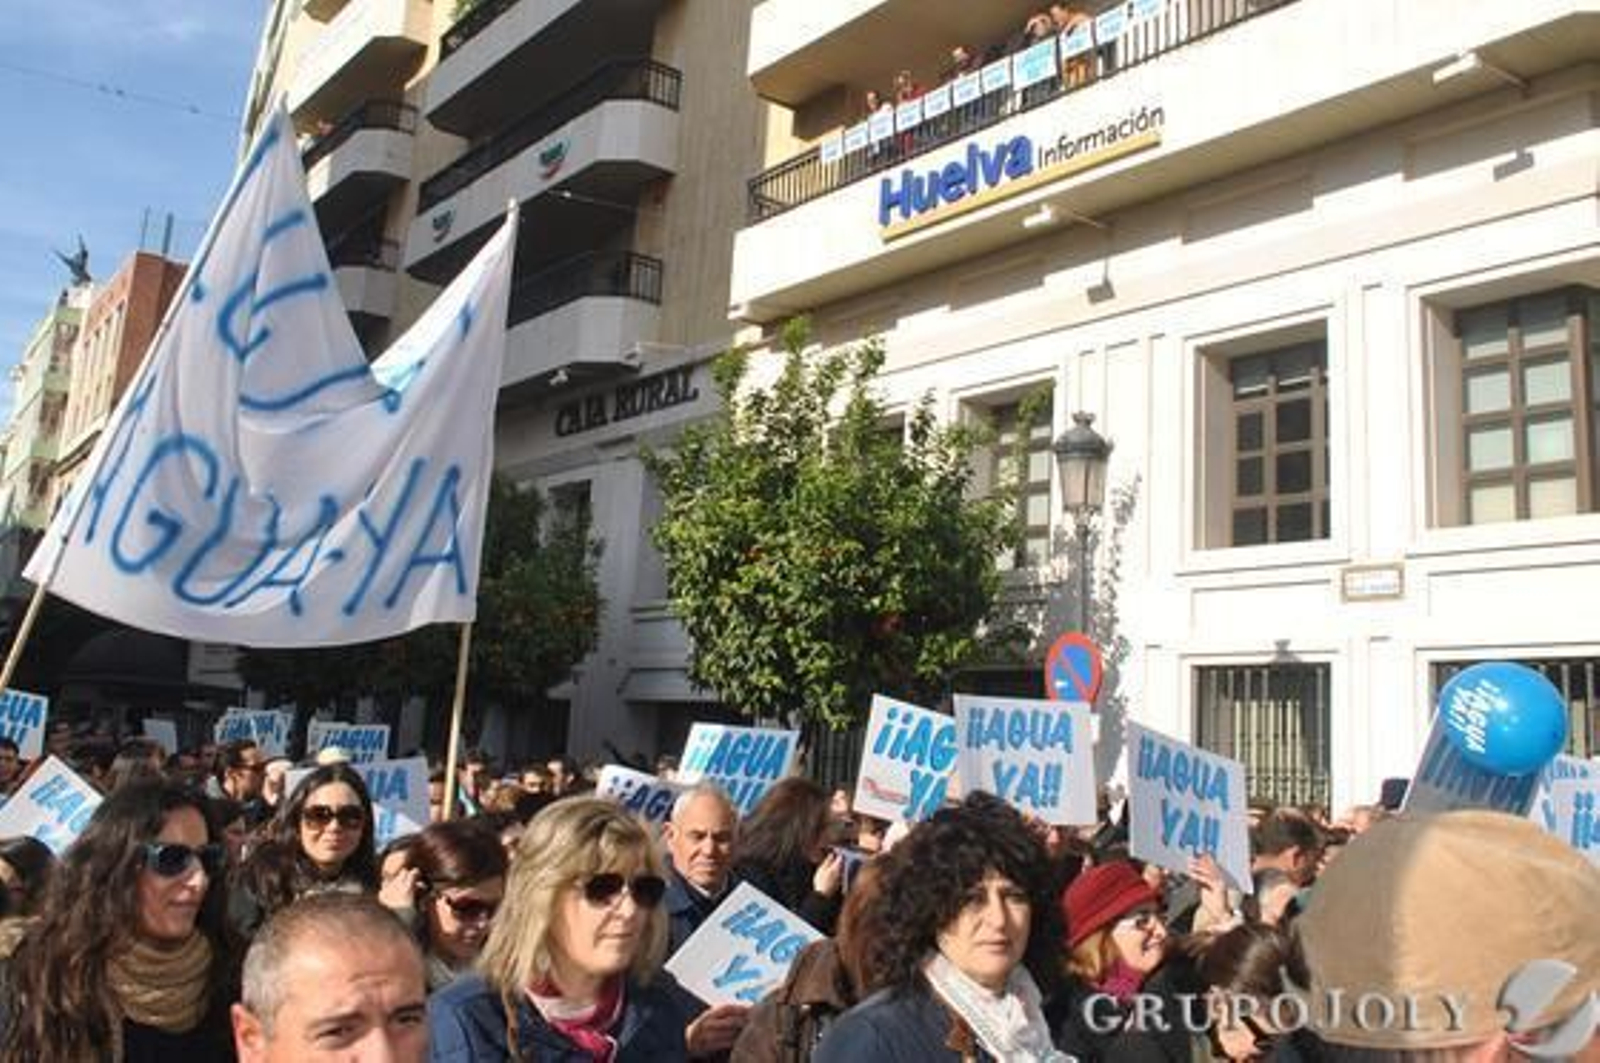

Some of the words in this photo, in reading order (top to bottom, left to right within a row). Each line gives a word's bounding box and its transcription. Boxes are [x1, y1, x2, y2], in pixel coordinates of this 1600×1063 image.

[878, 135, 1034, 226] Huelva
[1037, 104, 1165, 171] Información
[612, 365, 699, 421] RURAL
